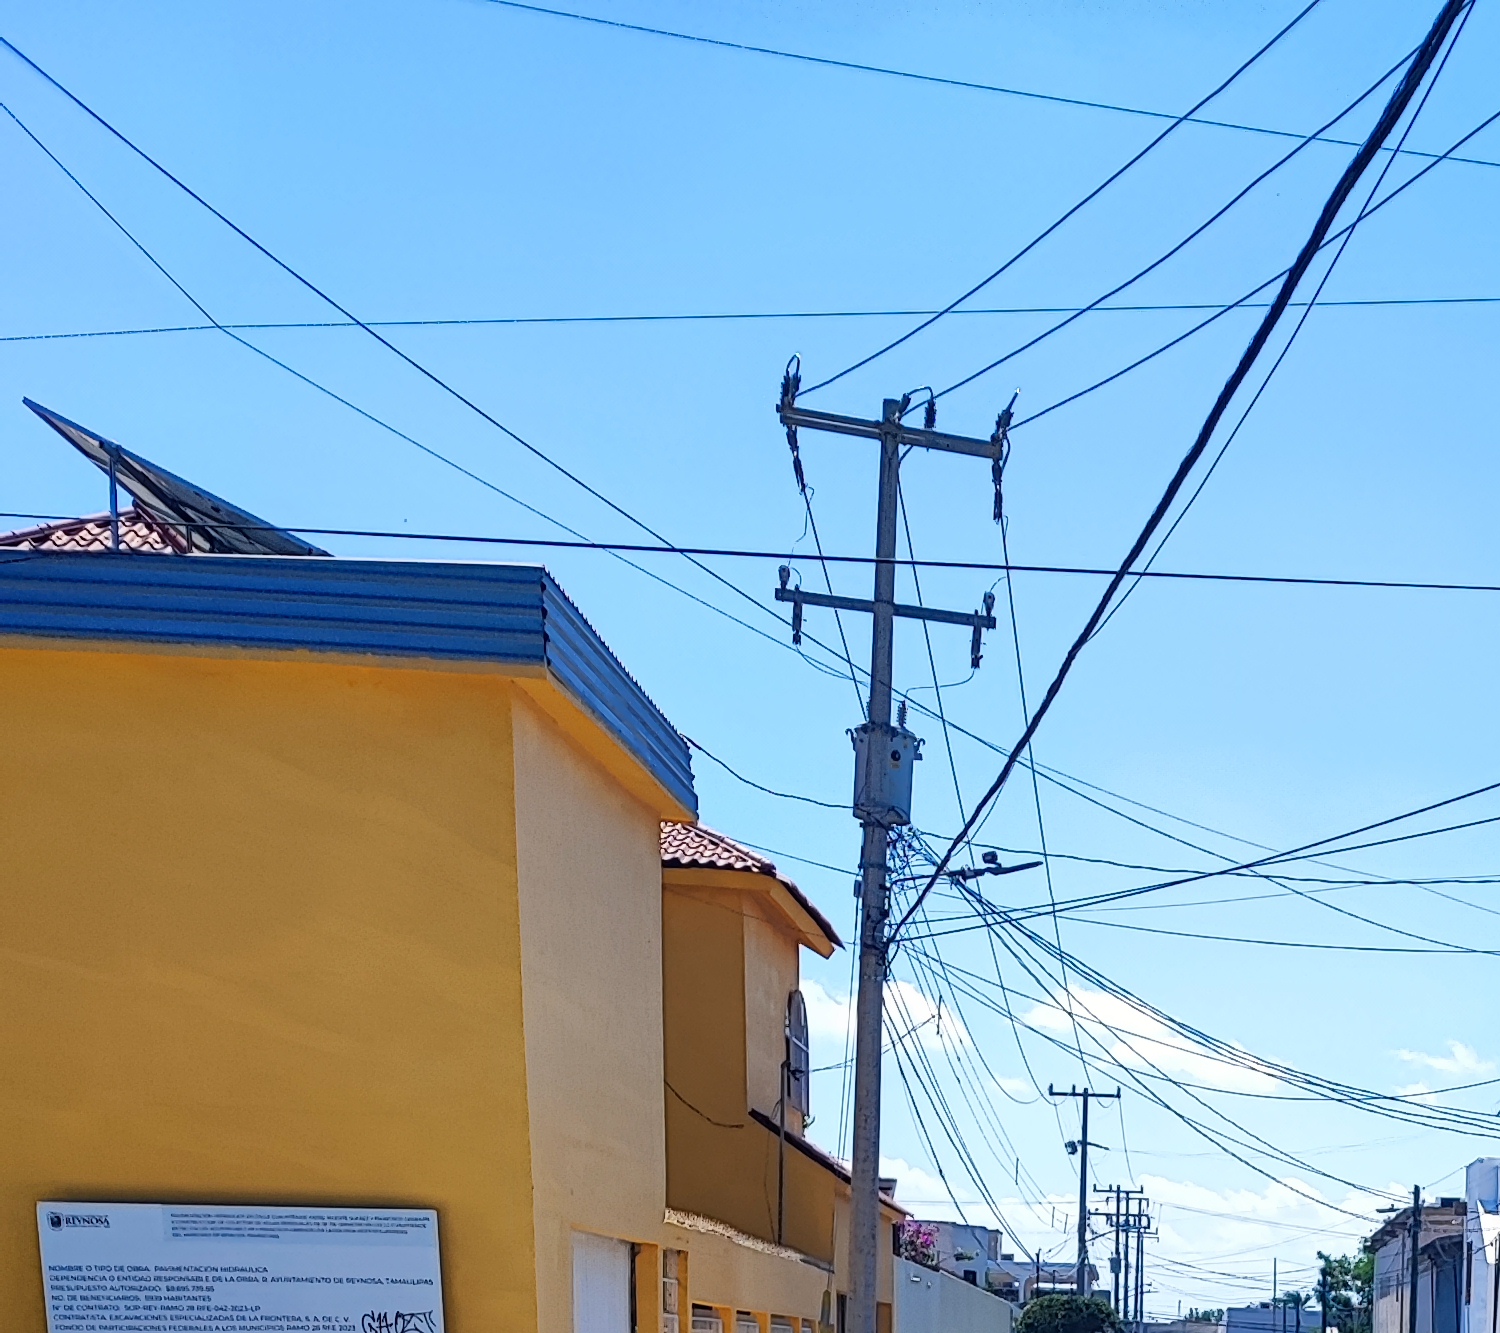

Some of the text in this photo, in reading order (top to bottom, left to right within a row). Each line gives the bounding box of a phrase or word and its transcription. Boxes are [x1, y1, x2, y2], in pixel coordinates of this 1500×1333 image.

[65, 1216, 110, 1227] REYNOSA
[211, 1275, 223, 1283] DE
[224, 1275, 235, 1283] LA
[63, 1304, 75, 1312] DE
